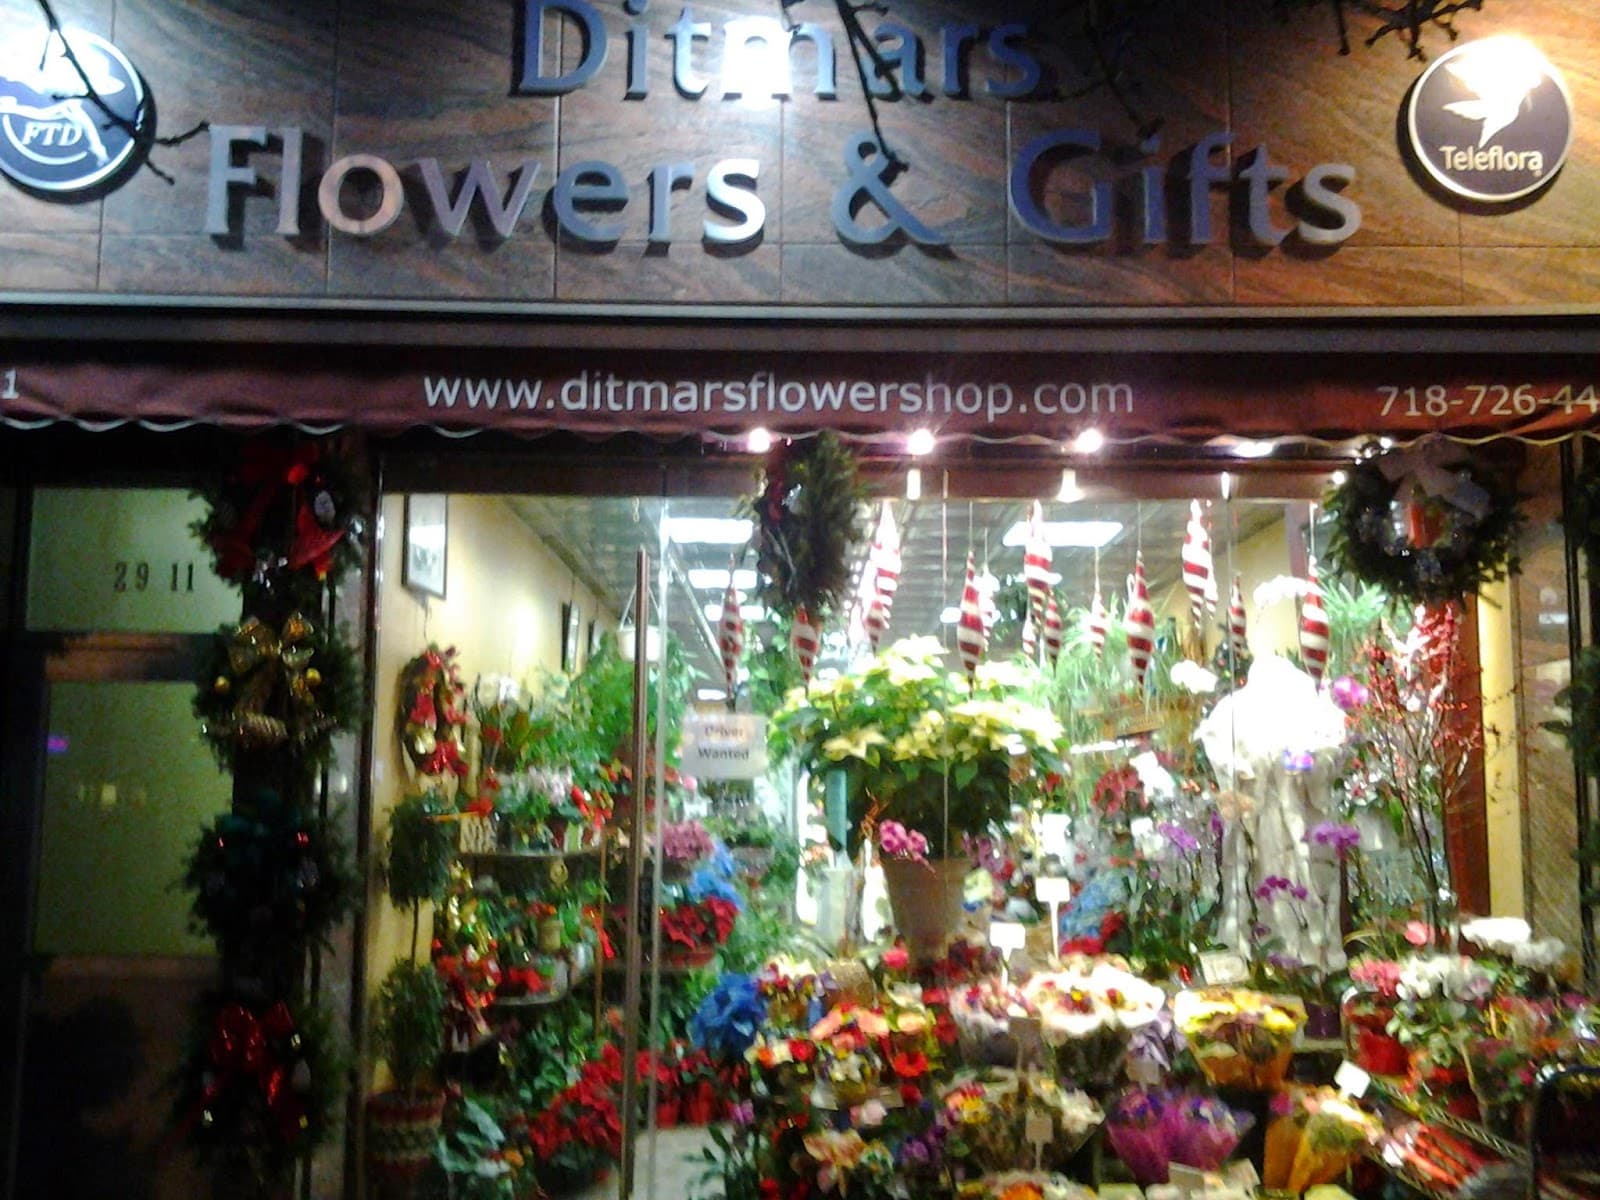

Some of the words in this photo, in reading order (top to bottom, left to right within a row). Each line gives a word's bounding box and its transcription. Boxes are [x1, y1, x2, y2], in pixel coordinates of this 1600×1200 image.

[516, 0, 1043, 98] Ditmars
[21, 121, 83, 146] FTD
[1438, 145, 1544, 172] Teleflora
[205, 123, 767, 244] Flowers
[831, 132, 949, 246] &
[1005, 129, 1363, 246] Gifts
[423, 370, 1135, 422] www.ditmarsflowershop.com
[1376, 383, 1600, 417] 718-726-44
[113, 560, 150, 593] 29
[170, 562, 194, 592] 11
[697, 747, 750, 761] Wanted
